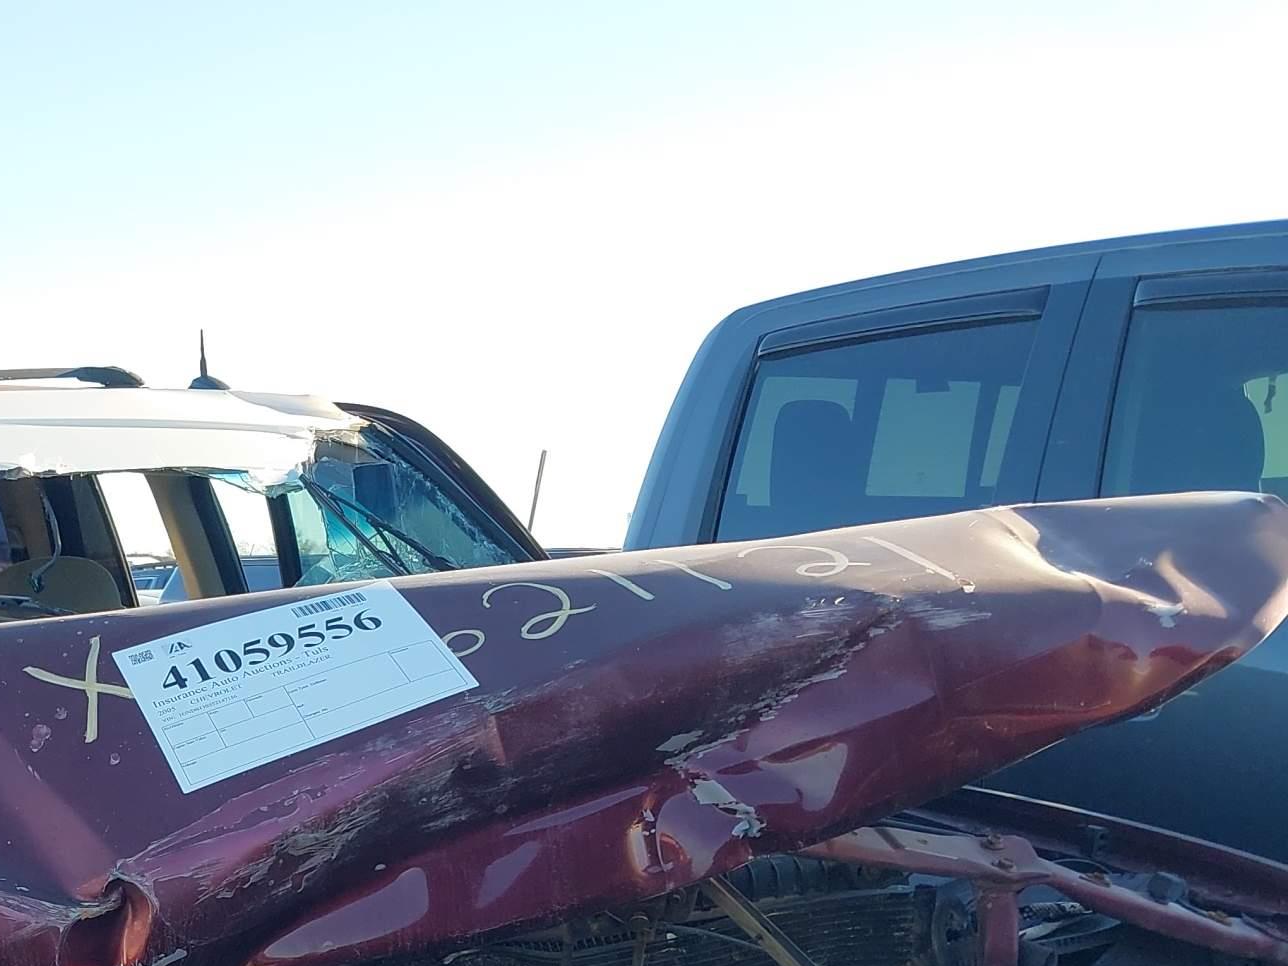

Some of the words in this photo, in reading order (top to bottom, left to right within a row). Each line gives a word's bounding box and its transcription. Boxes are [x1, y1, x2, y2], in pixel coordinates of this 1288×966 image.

[162, 608, 383, 690] 41059556
[152, 686, 208, 709] Insurance
[211, 675, 239, 690] Auto
[242, 657, 293, 679] Auctions
[189, 683, 243, 705] CHEVROLET
